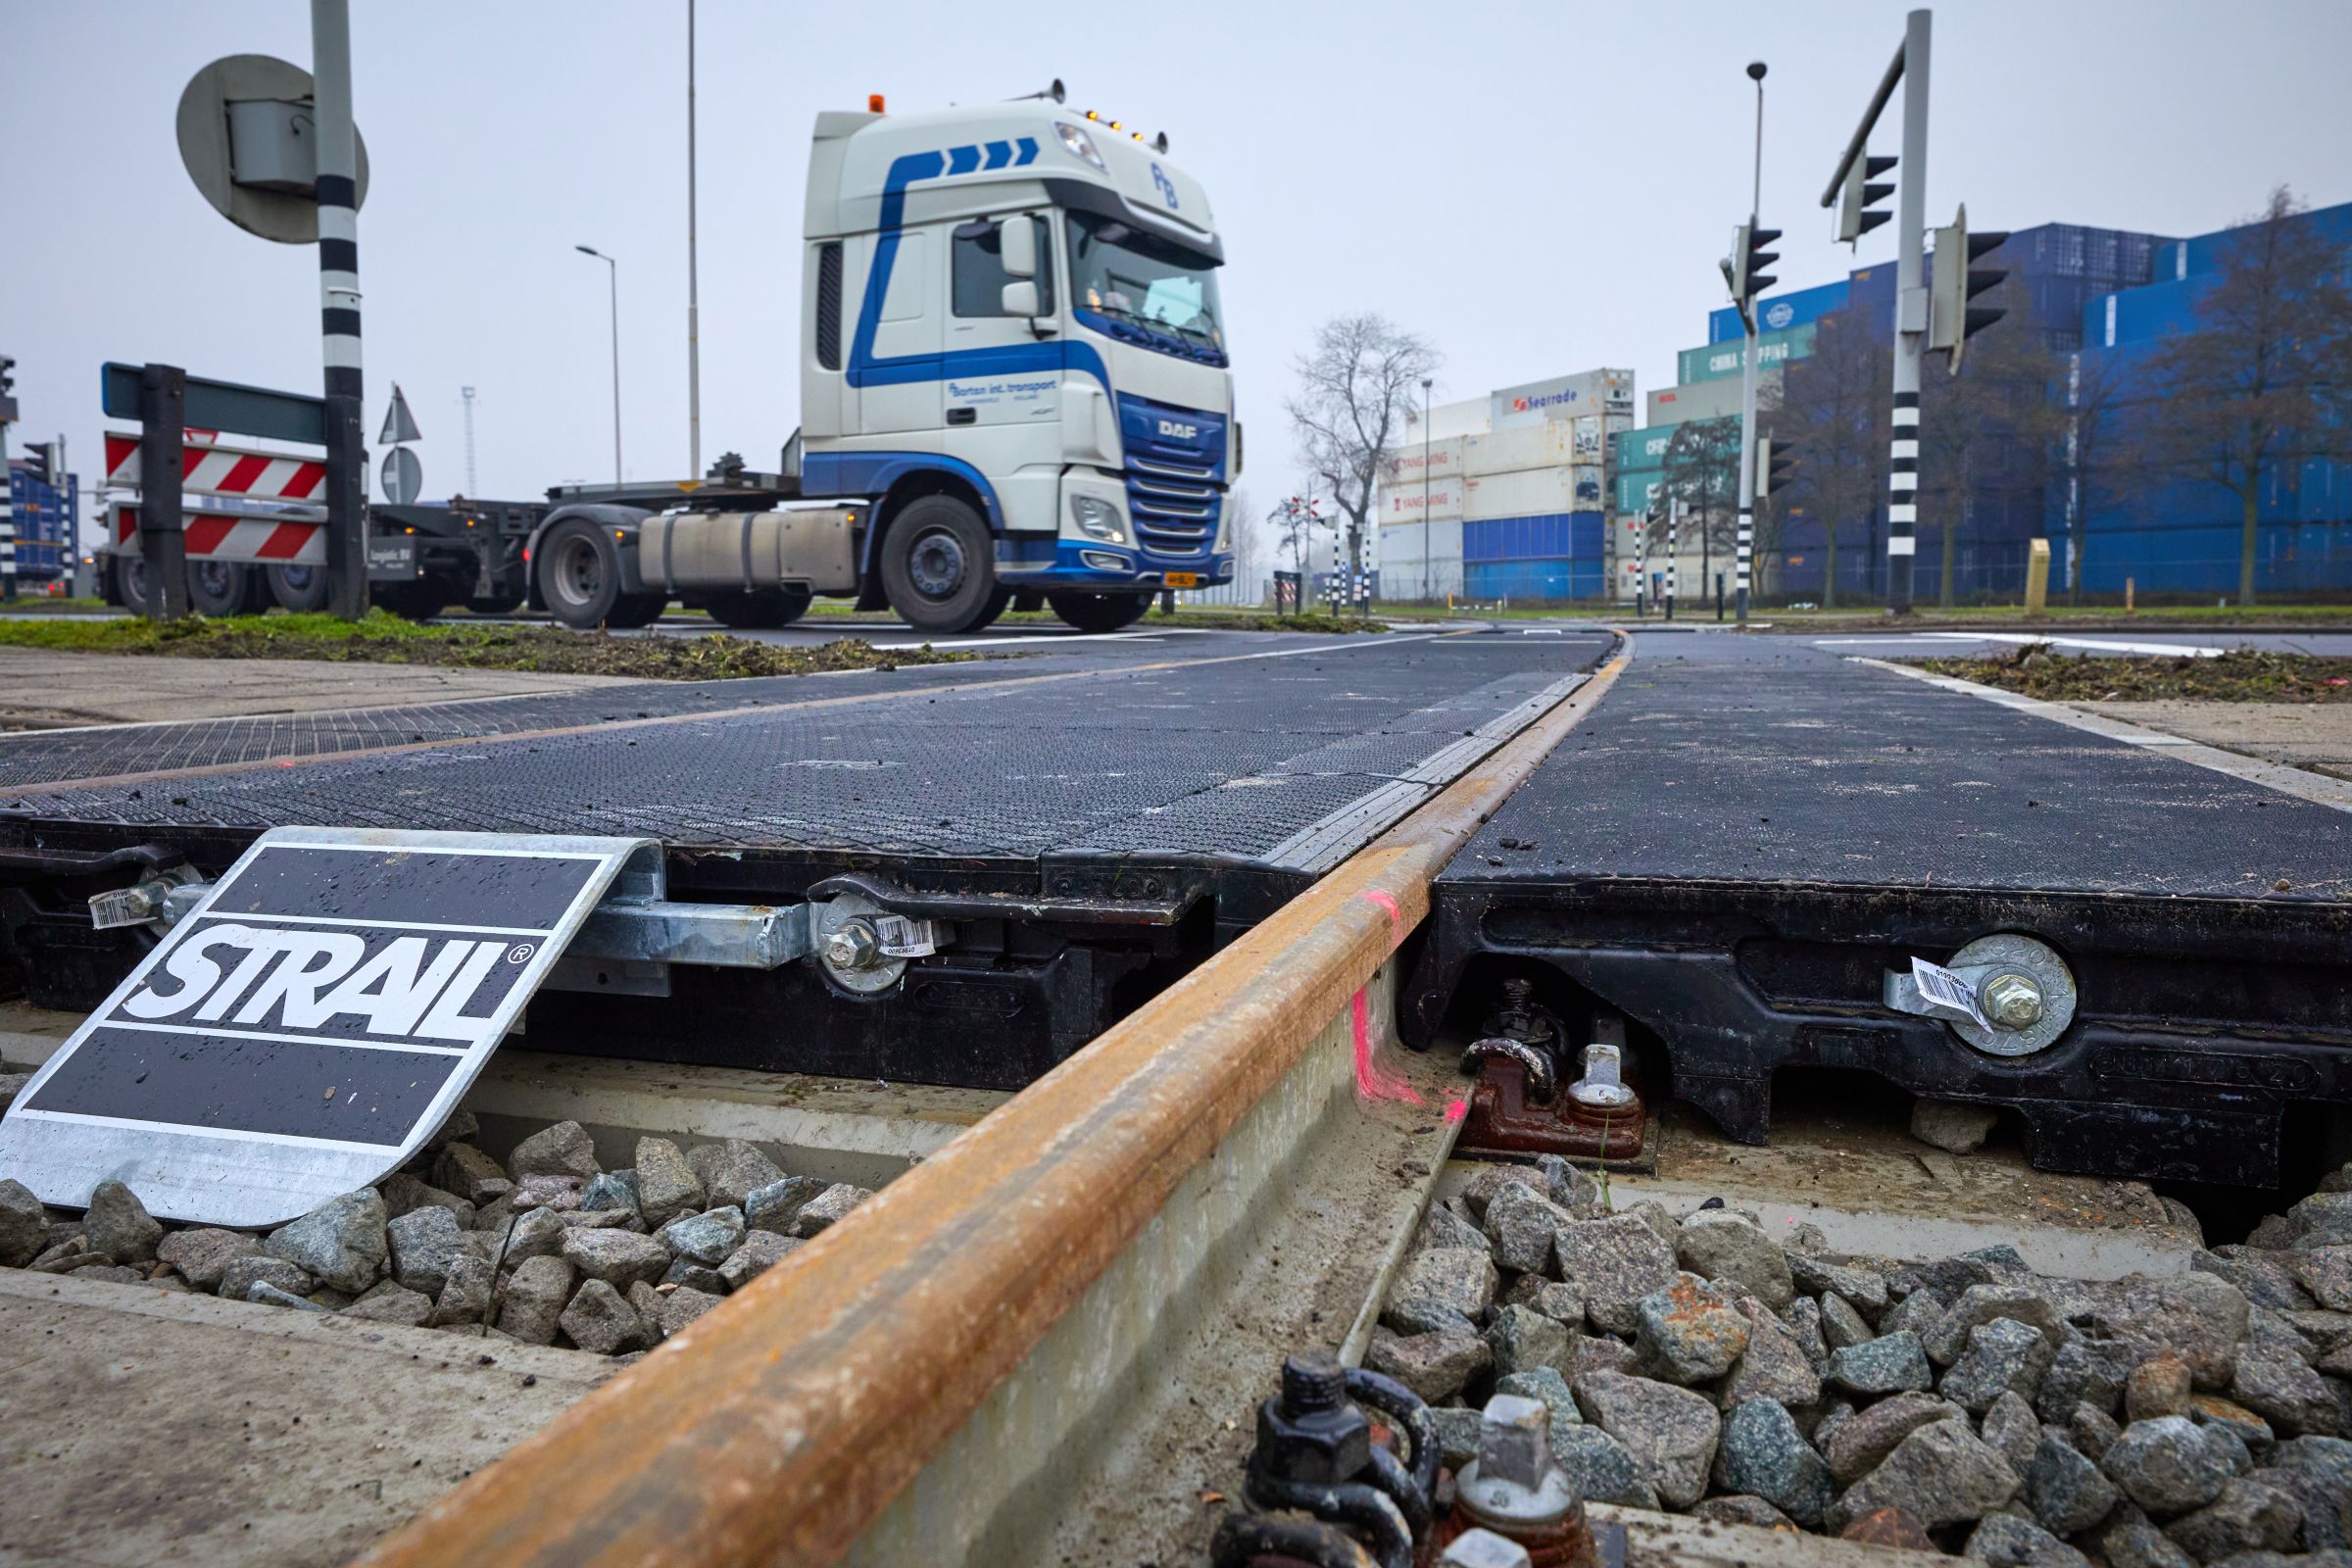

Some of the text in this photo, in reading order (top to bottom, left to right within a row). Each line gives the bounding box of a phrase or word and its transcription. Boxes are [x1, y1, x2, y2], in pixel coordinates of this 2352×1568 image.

[1709, 352, 1738, 371] CHINA
[1007, 380, 1056, 394] transport
[1159, 420, 1197, 439] DAF
[1401, 455, 1424, 468] YANG
[1402, 495, 1424, 509] YANG
